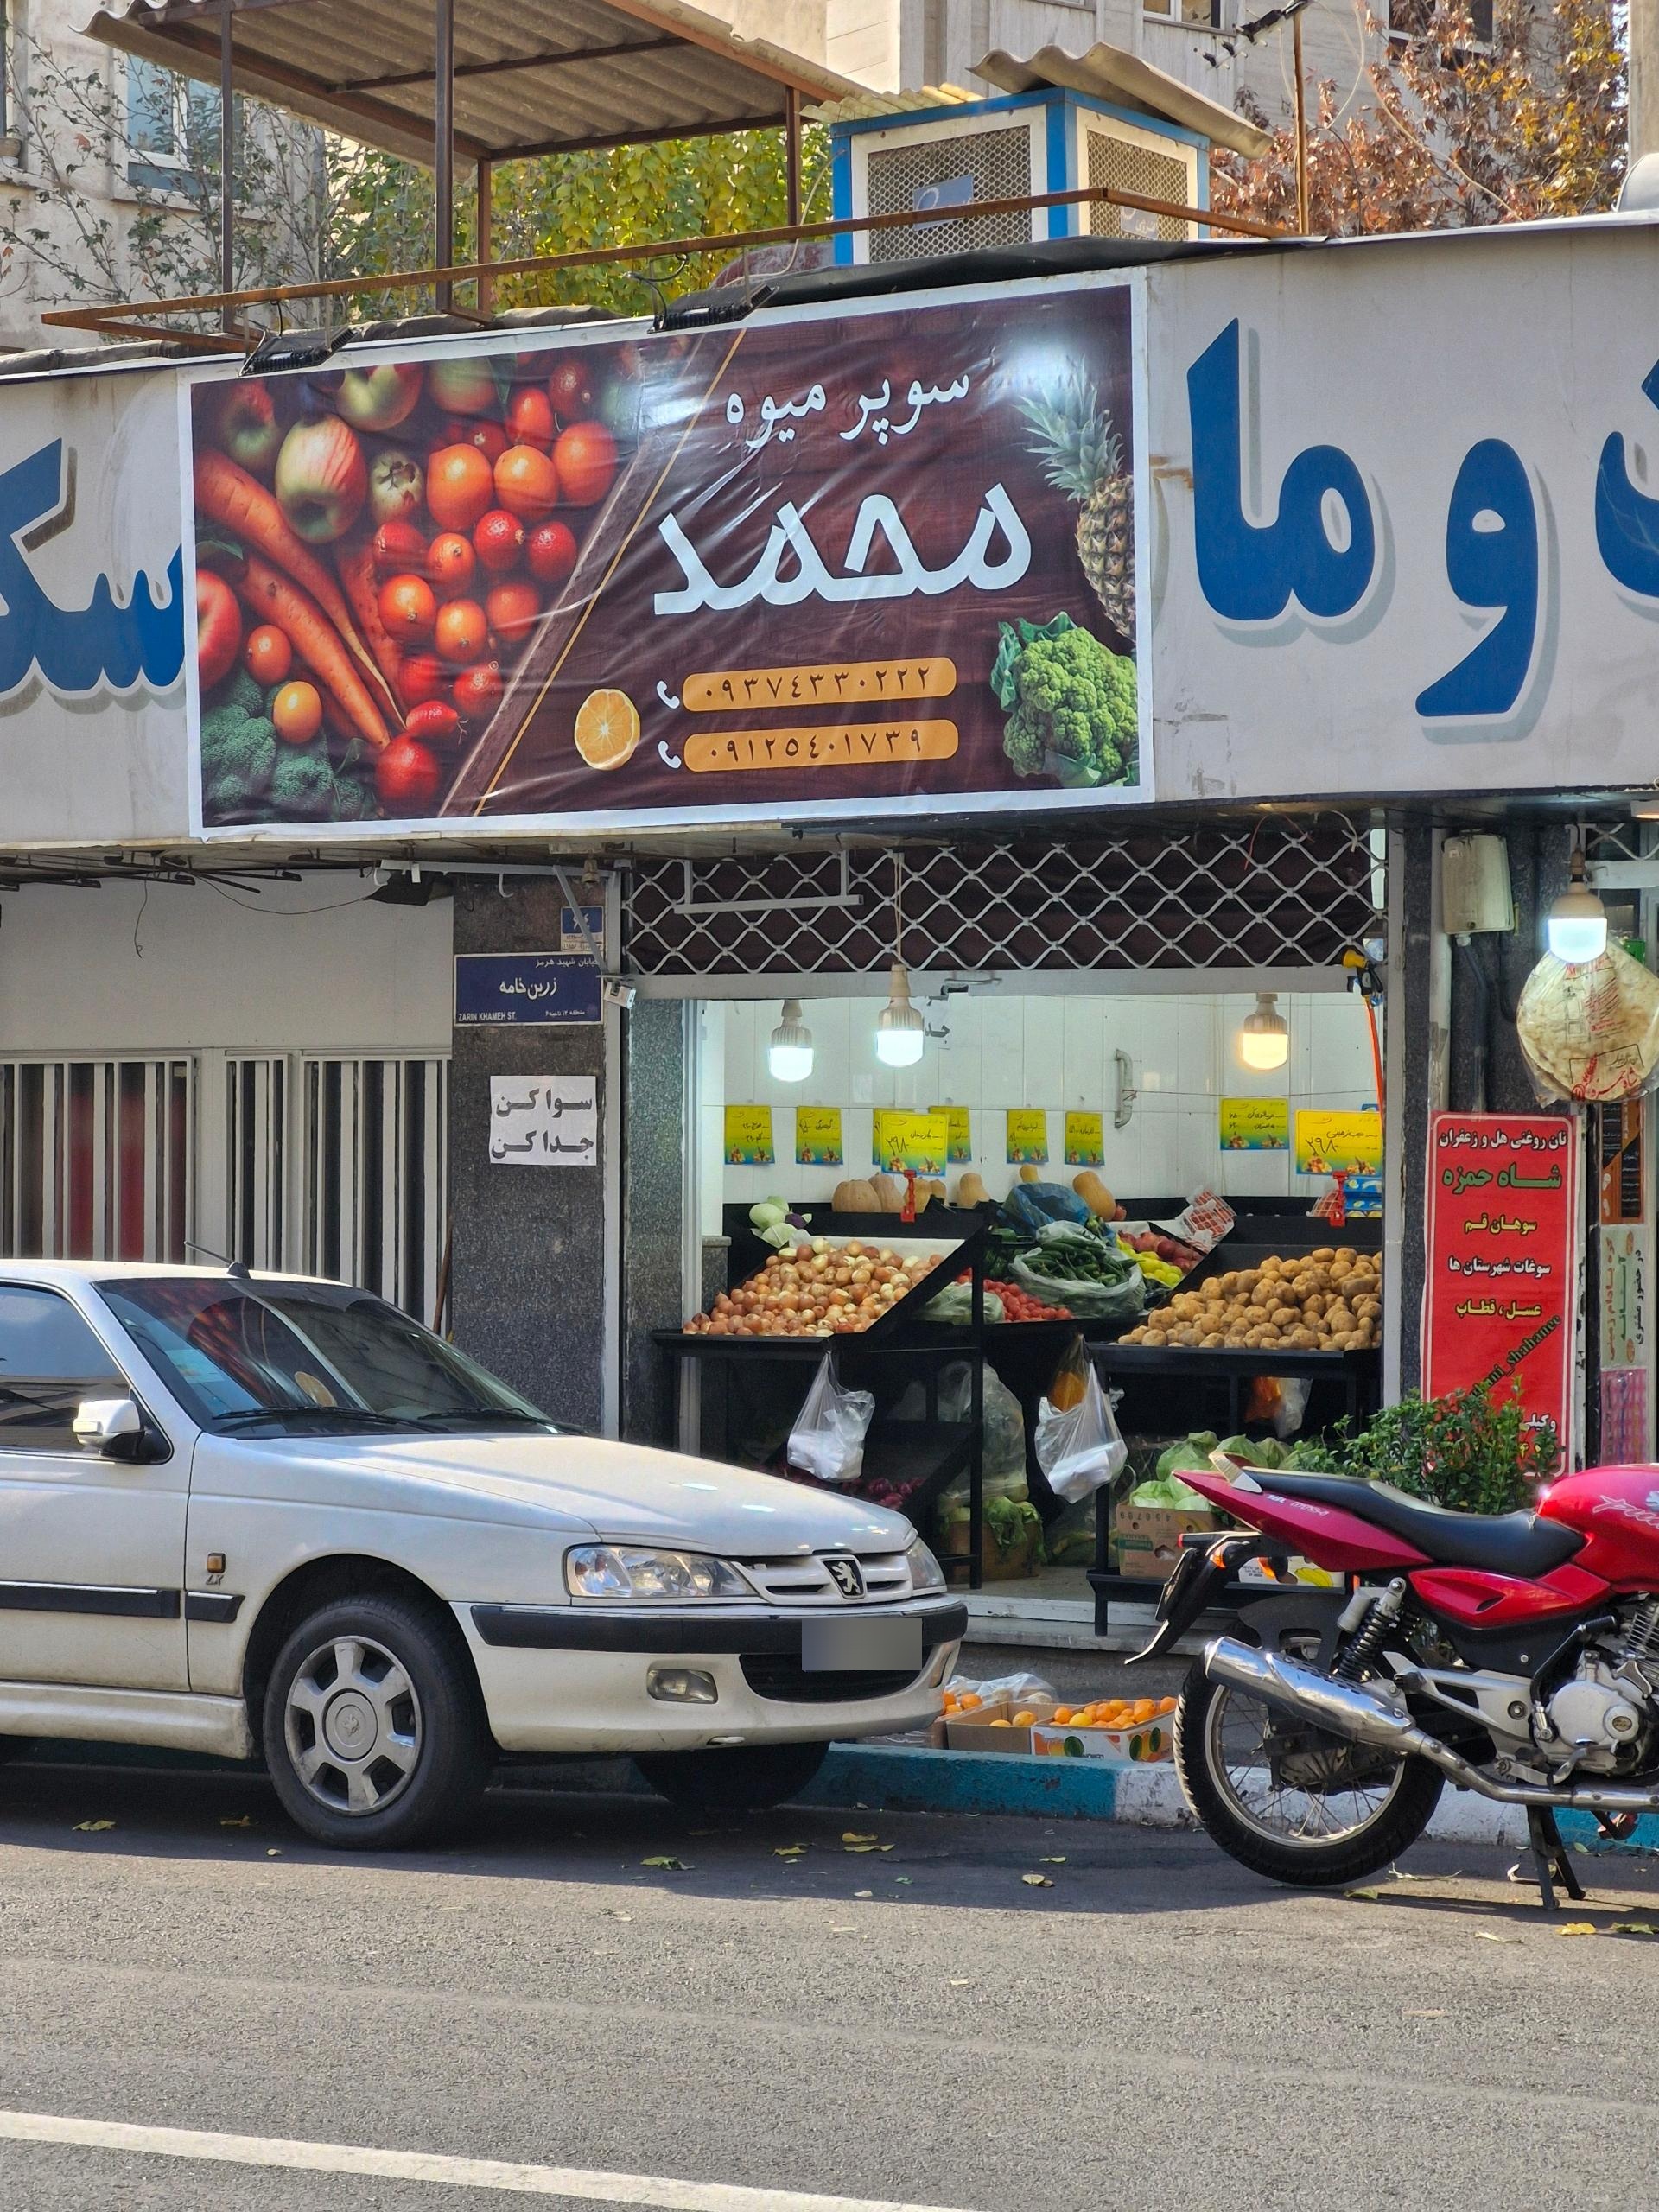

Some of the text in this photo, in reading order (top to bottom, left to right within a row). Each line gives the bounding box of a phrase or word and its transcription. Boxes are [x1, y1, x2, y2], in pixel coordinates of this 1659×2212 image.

[725, 372, 969, 449] سوپر میوه
[653, 481, 1033, 616] محمد
[556, 957, 576, 968] شهید
[458, 1013, 478, 1021] ZARIN
[479, 1011, 506, 1021] KHAMEH
[495, 1088, 593, 1118] سوا کن
[491, 1130, 594, 1160] جدا کن
[1439, 1127, 1567, 1150] نان روغنی هل و زعفران
[1442, 1161, 1562, 1195] شاه حمزه
[1465, 1212, 1537, 1235] سوهان قم
[1448, 1255, 1552, 1279] سوغات شهرستان ها
[1455, 1298, 1497, 1319] قطاب
